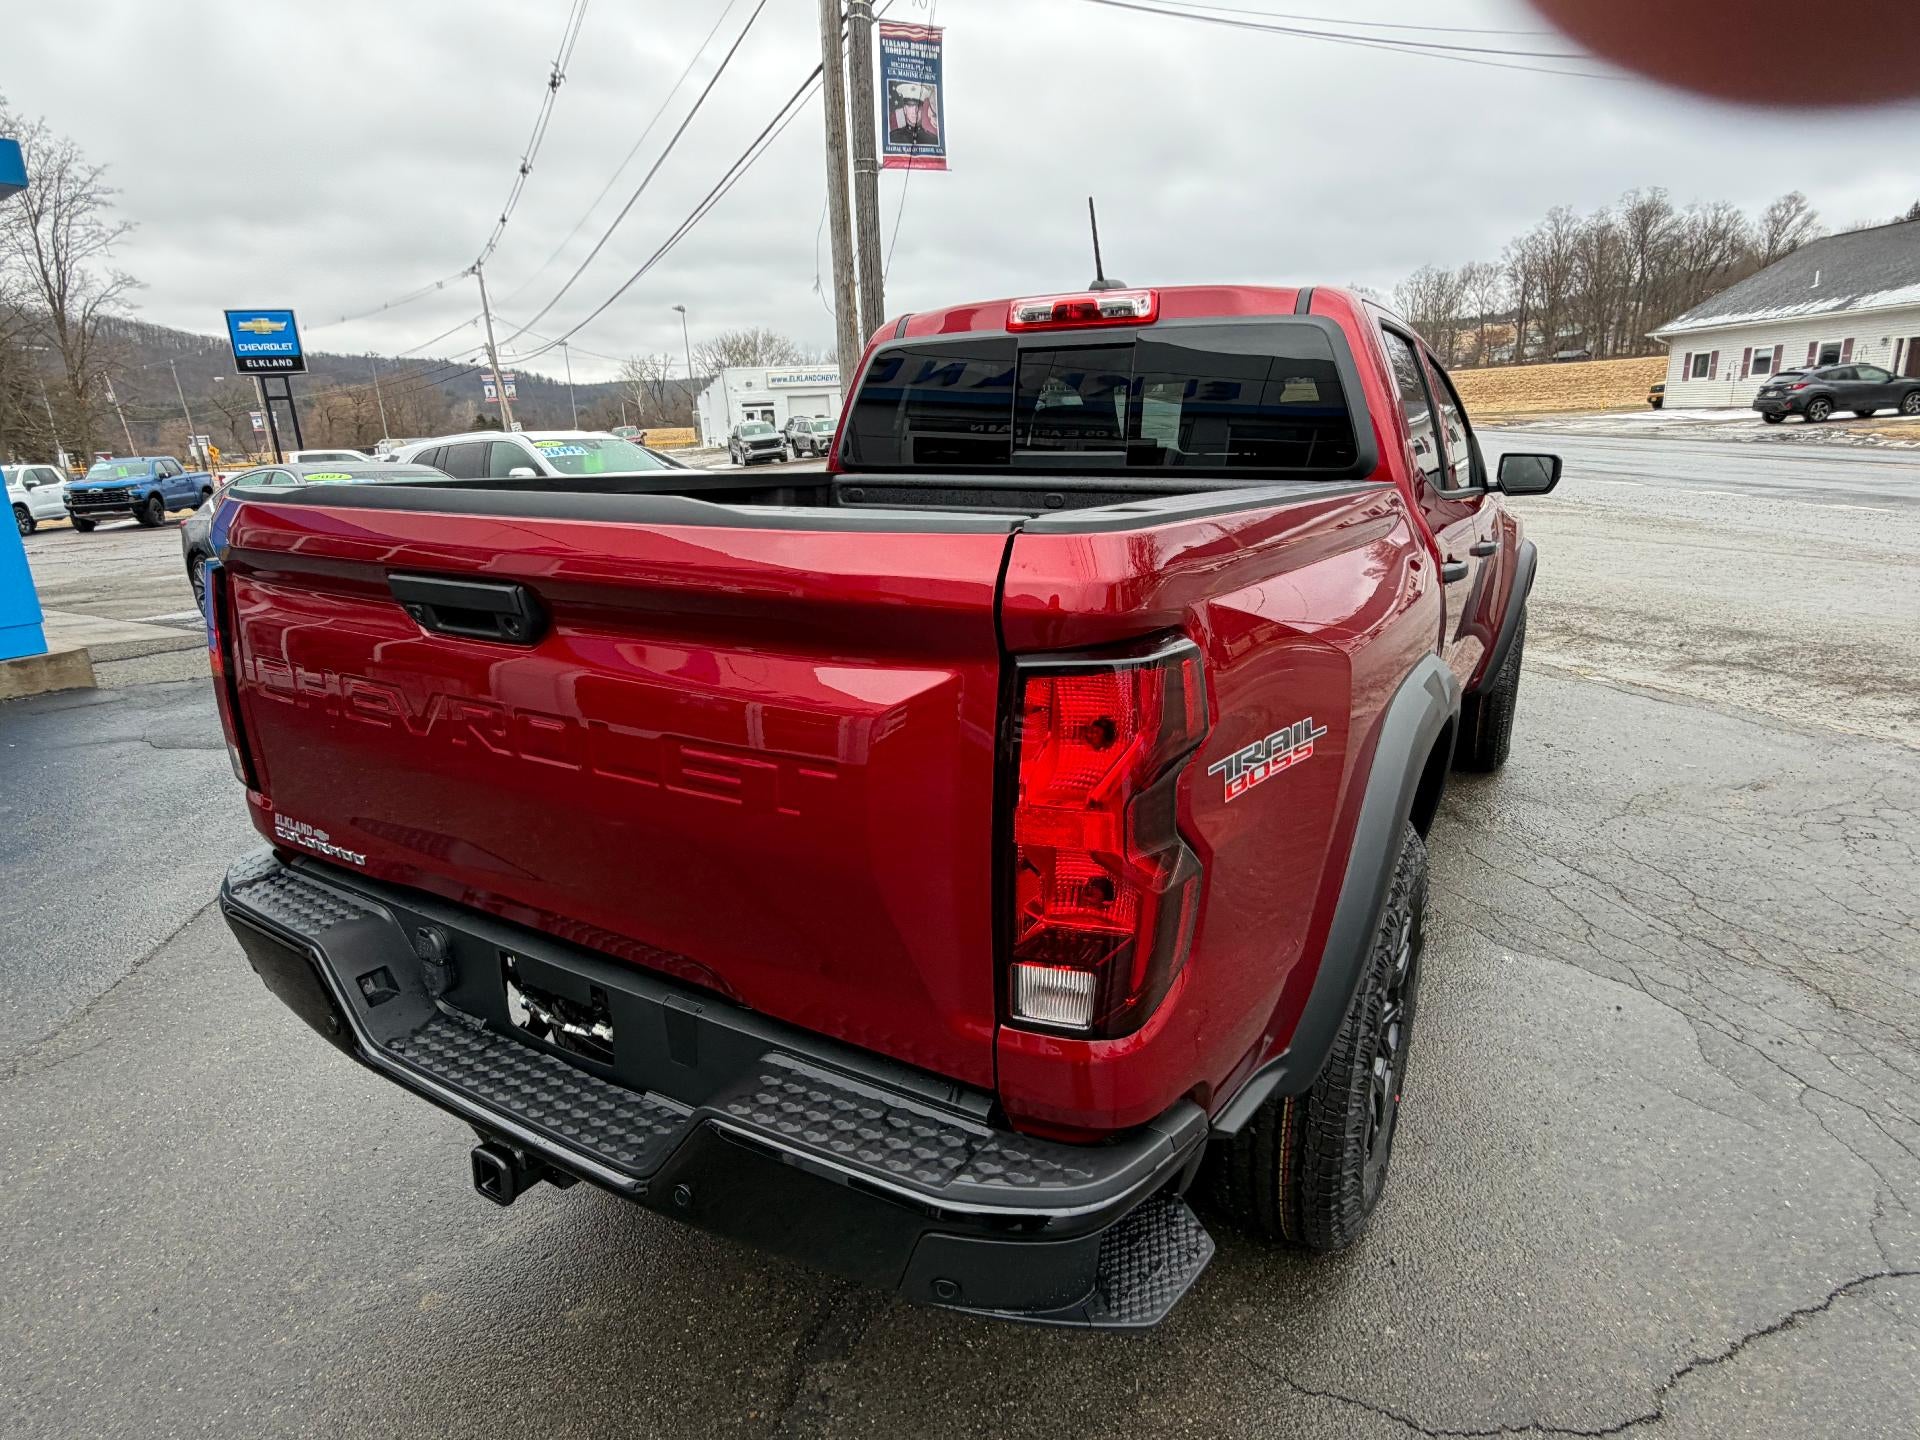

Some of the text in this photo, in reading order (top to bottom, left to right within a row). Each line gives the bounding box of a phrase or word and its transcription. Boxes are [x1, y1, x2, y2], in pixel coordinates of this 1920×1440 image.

[882, 38, 909, 50] ELKLAND
[885, 46, 920, 57] HOMETOWN
[238, 342, 294, 352] CHEVROLET
[246, 359, 294, 368] ELKLAND
[253, 653, 839, 816] CHEVROLET
[1208, 716, 1328, 785] TRAIL
[1225, 738, 1313, 804] BOSS
[274, 812, 313, 837] ELKLAND
[274, 826, 366, 865] COLORADO
